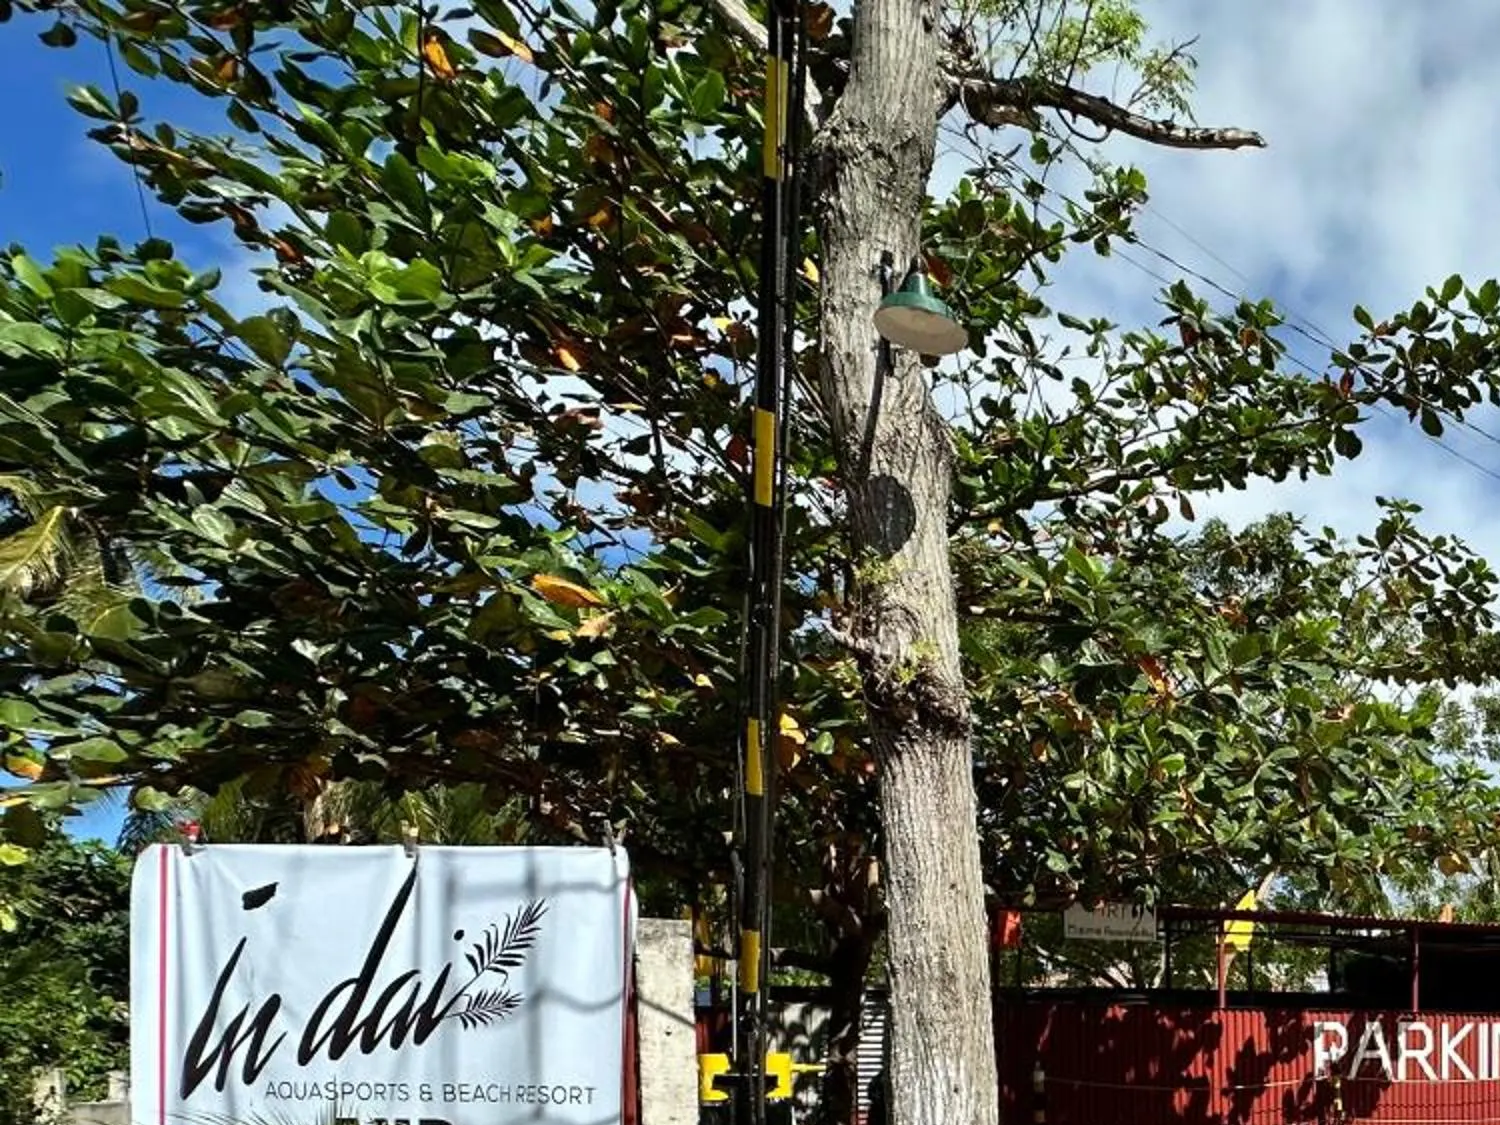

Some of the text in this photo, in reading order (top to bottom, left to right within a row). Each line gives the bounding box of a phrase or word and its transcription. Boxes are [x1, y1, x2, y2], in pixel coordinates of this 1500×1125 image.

[265, 1080, 597, 1105] AQUASPORTS & BEACH RESORT
